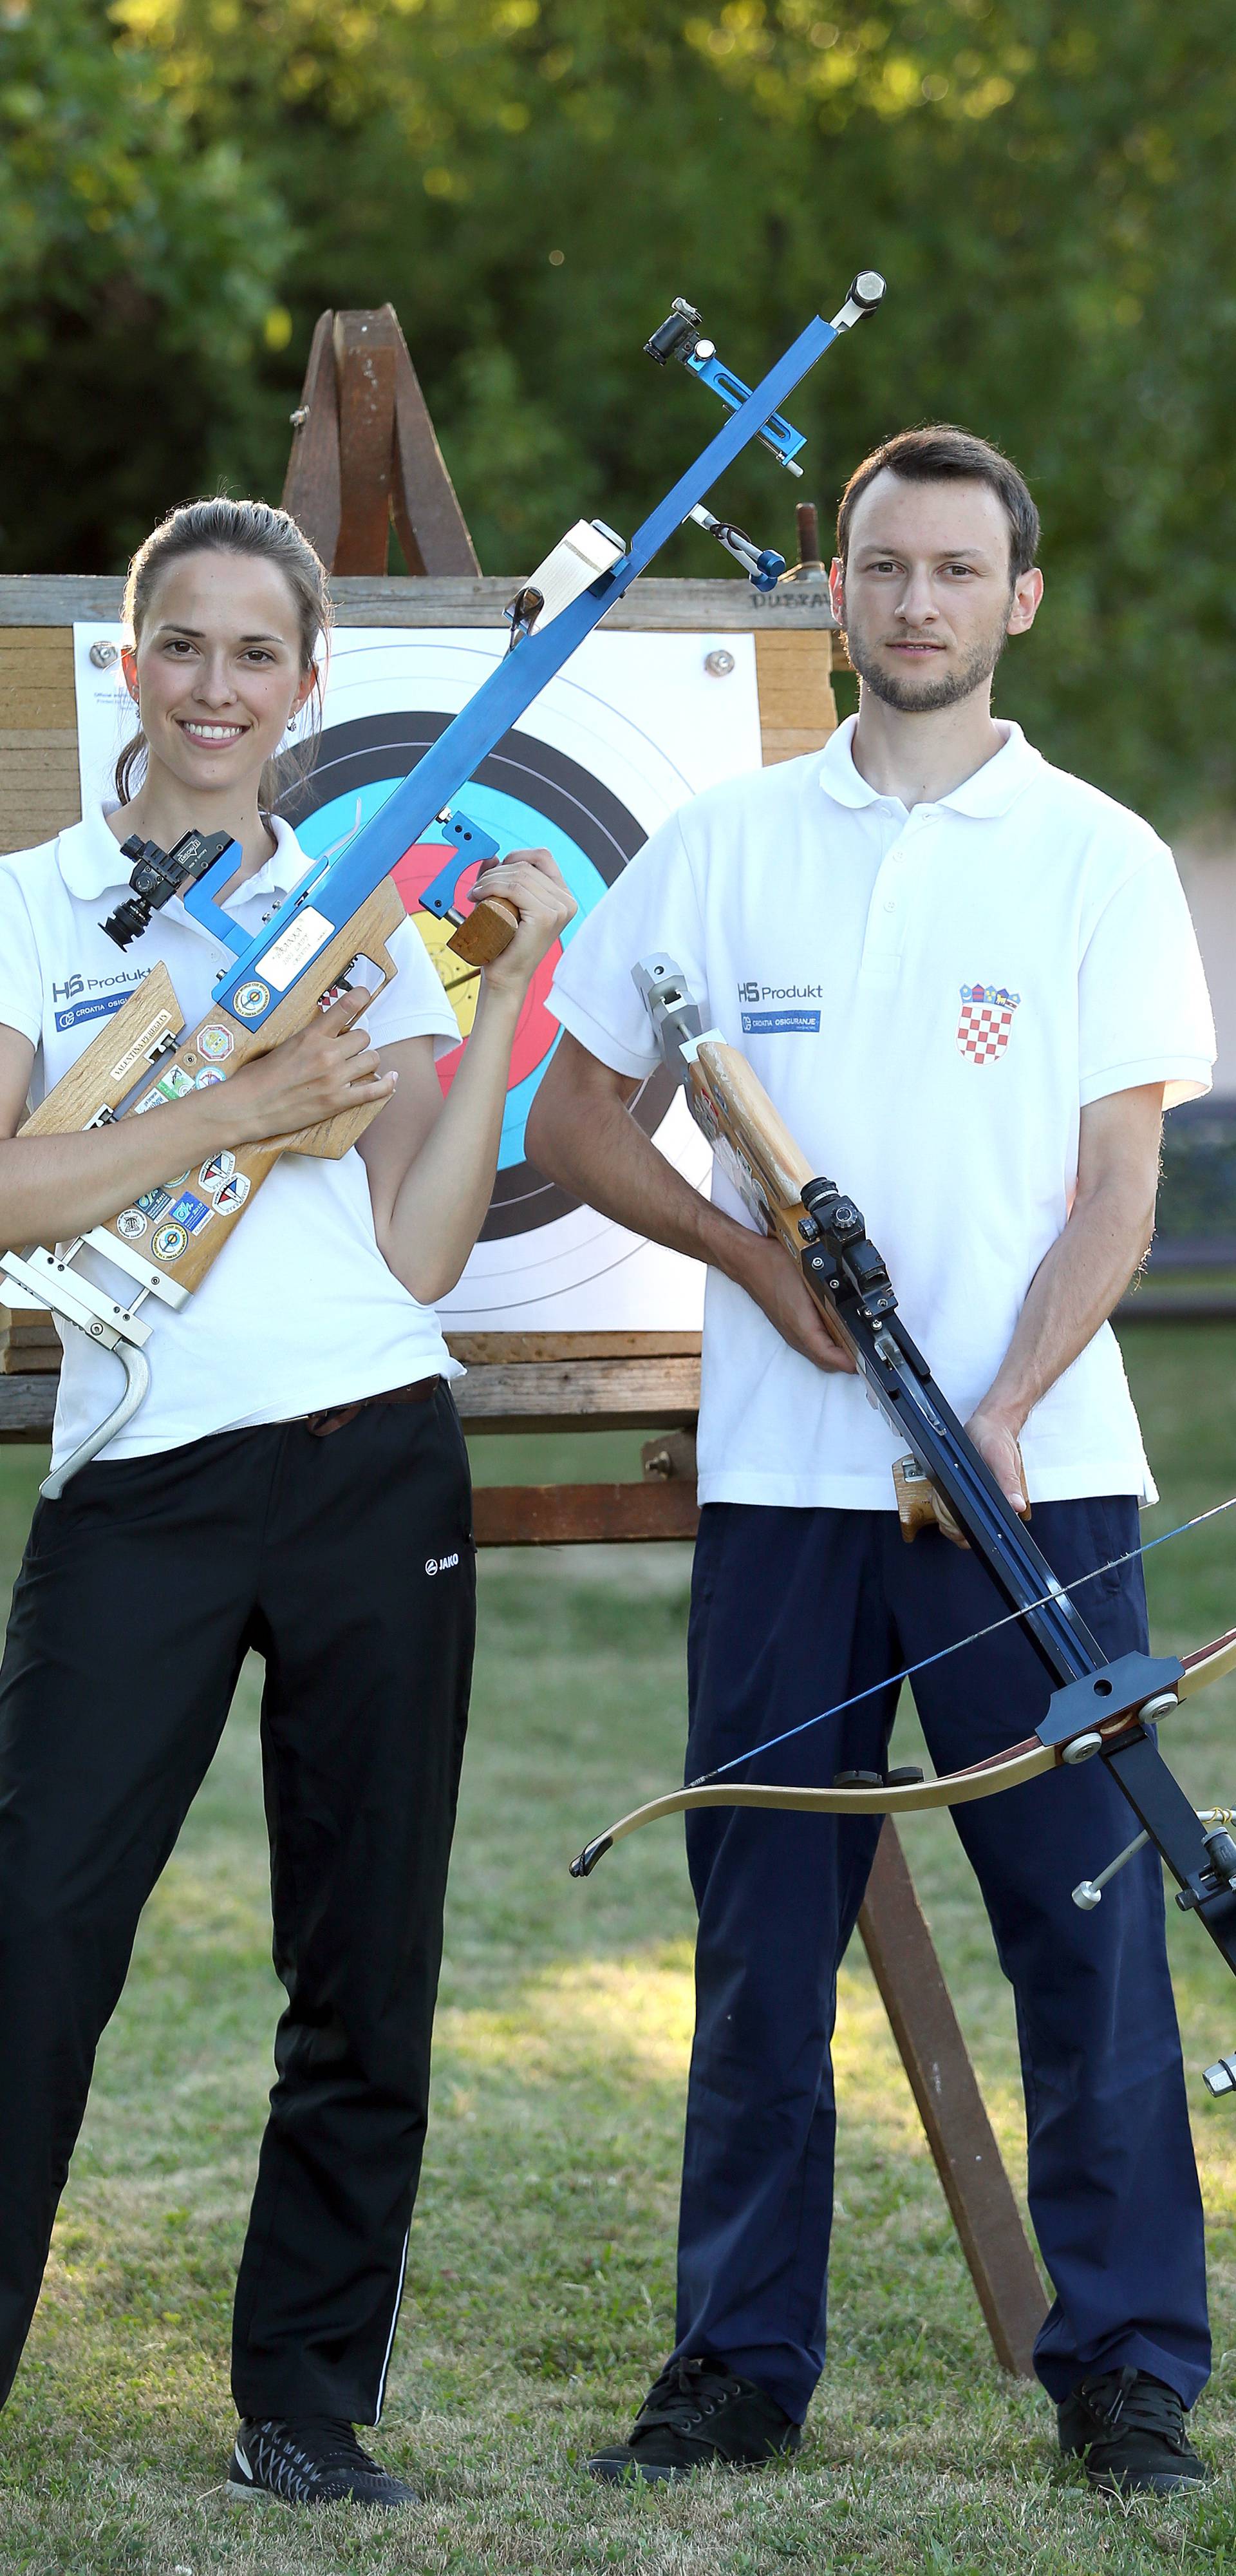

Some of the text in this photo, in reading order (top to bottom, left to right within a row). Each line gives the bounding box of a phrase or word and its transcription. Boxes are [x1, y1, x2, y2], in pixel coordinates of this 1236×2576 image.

[53, 974, 84, 1003] HS
[738, 982, 823, 1003] HS Produkt
[75, 1004, 105, 1017] CROATIA
[115, 1043, 144, 1075] VALENTINA
[439, 1553, 458, 1570] JAKO
